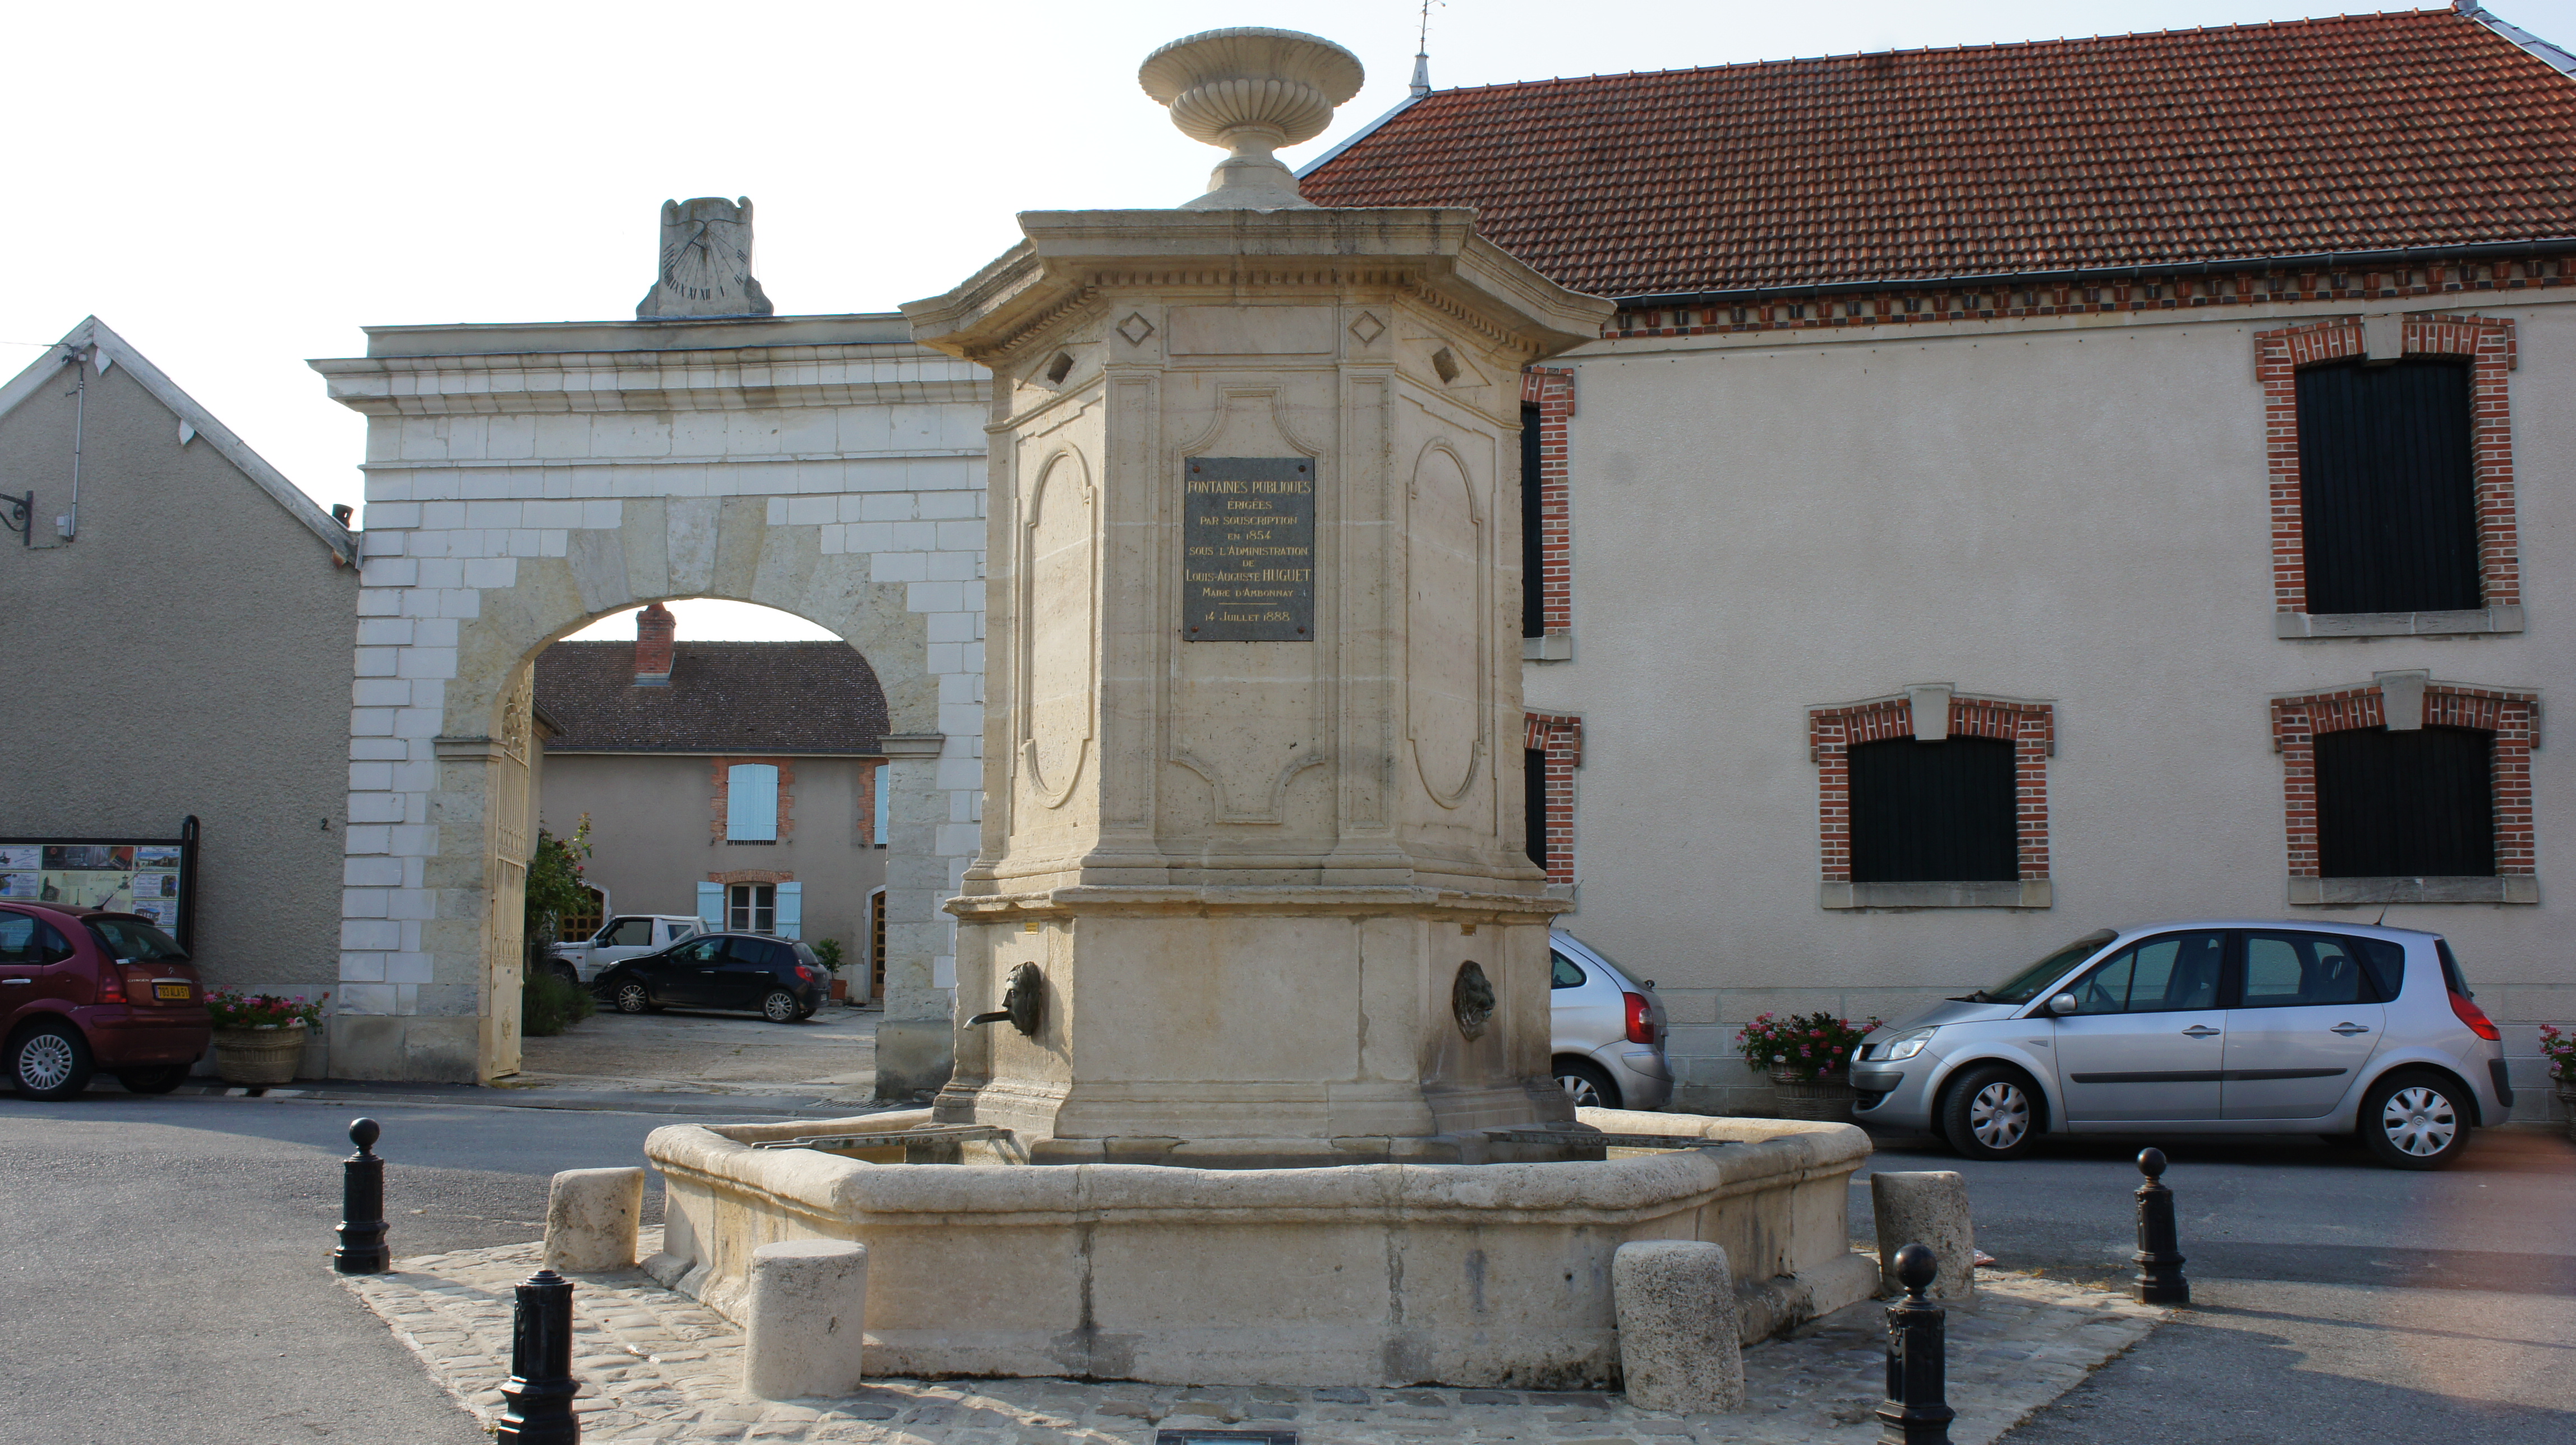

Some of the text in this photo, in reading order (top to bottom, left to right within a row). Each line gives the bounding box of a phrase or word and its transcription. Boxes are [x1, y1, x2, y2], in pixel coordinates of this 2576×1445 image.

[700, 288, 711, 301] XII
[1188, 481, 1311, 495] FONTAINES PUBLIQUES
[1227, 498, 1273, 510] ÉRIGÉES
[1200, 516, 1298, 525] PAR SOUSCRIPTION
[1246, 530, 1271, 540] 1854
[1189, 546, 1308, 556] SOUS L'ADMINISTRATION
[1263, 569, 1311, 582] HUGUET
[1202, 587, 1231, 597] MAIRE
[1205, 611, 1290, 622] 14 JUILLET 1888
